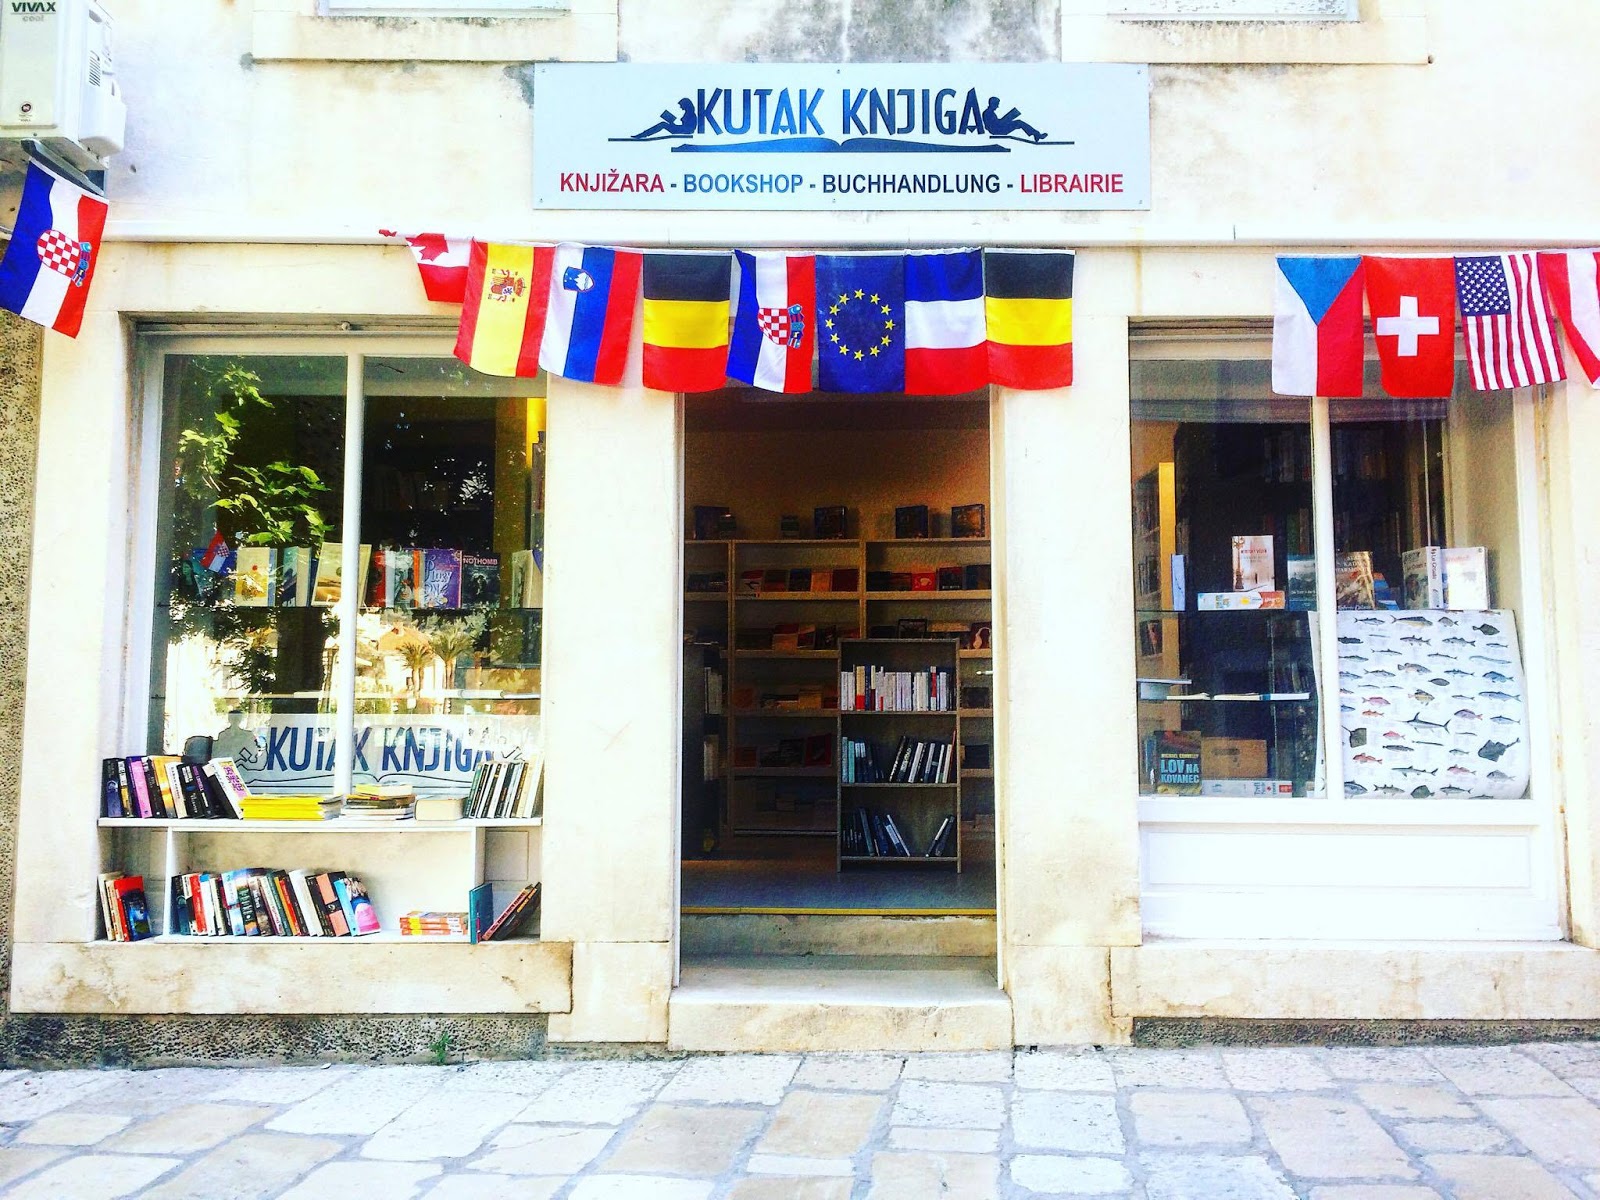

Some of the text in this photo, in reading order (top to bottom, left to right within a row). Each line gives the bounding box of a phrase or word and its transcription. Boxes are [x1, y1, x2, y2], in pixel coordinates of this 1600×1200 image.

[11, 2, 56, 13] VIVAX
[697, 87, 986, 136] KUTAK KNJIGA
[560, 168, 665, 193] KNJIŽARA
[683, 173, 804, 194] BOOKSHOP
[822, 173, 1001, 195] BUCHHANDLUNG
[1020, 173, 1124, 193] LIBRAIRIE
[463, 557, 498, 566] NOTHOMB
[1160, 759, 1199, 774] LOV NA
[1161, 774, 1200, 784] KOVANEC
